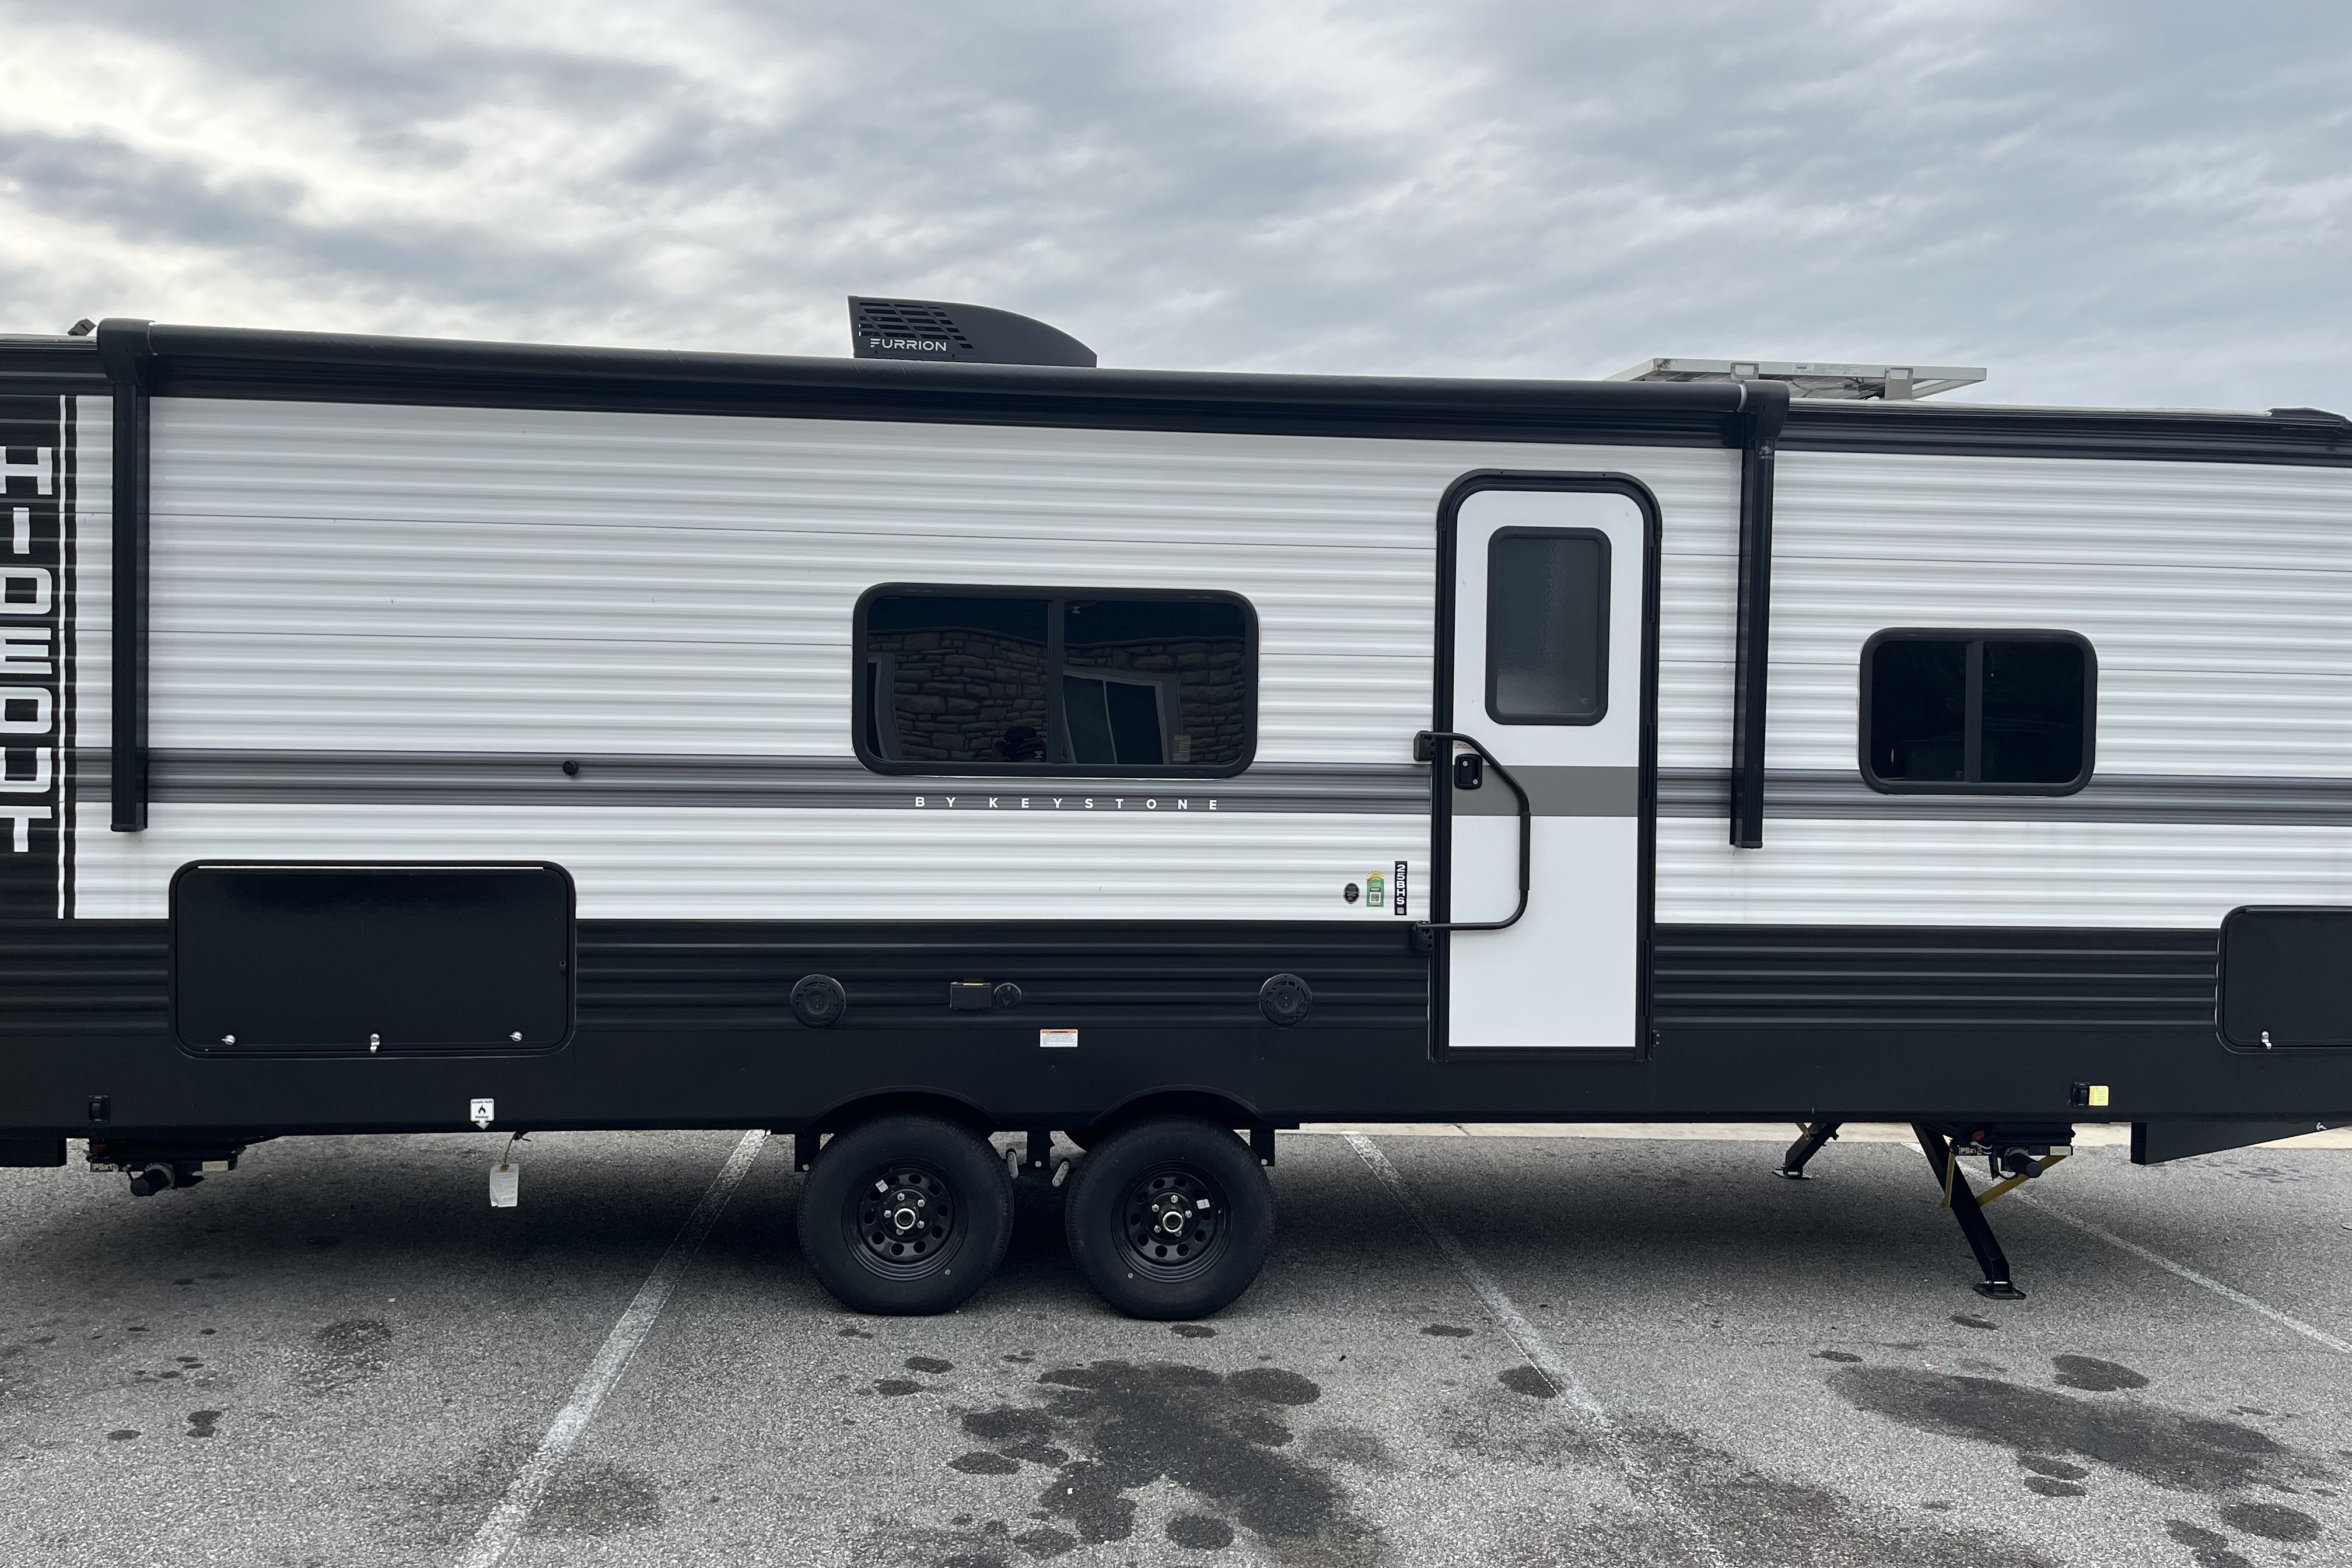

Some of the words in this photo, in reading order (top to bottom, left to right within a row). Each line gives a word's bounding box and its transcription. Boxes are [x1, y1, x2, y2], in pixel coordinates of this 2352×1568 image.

[870, 338, 947, 352] FURRION
[0, 446, 53, 853] HIDEOUT
[915, 796, 957, 808] BY
[988, 797, 1217, 810] KEYSTONE
[1396, 864, 1406, 905] 25BHS
